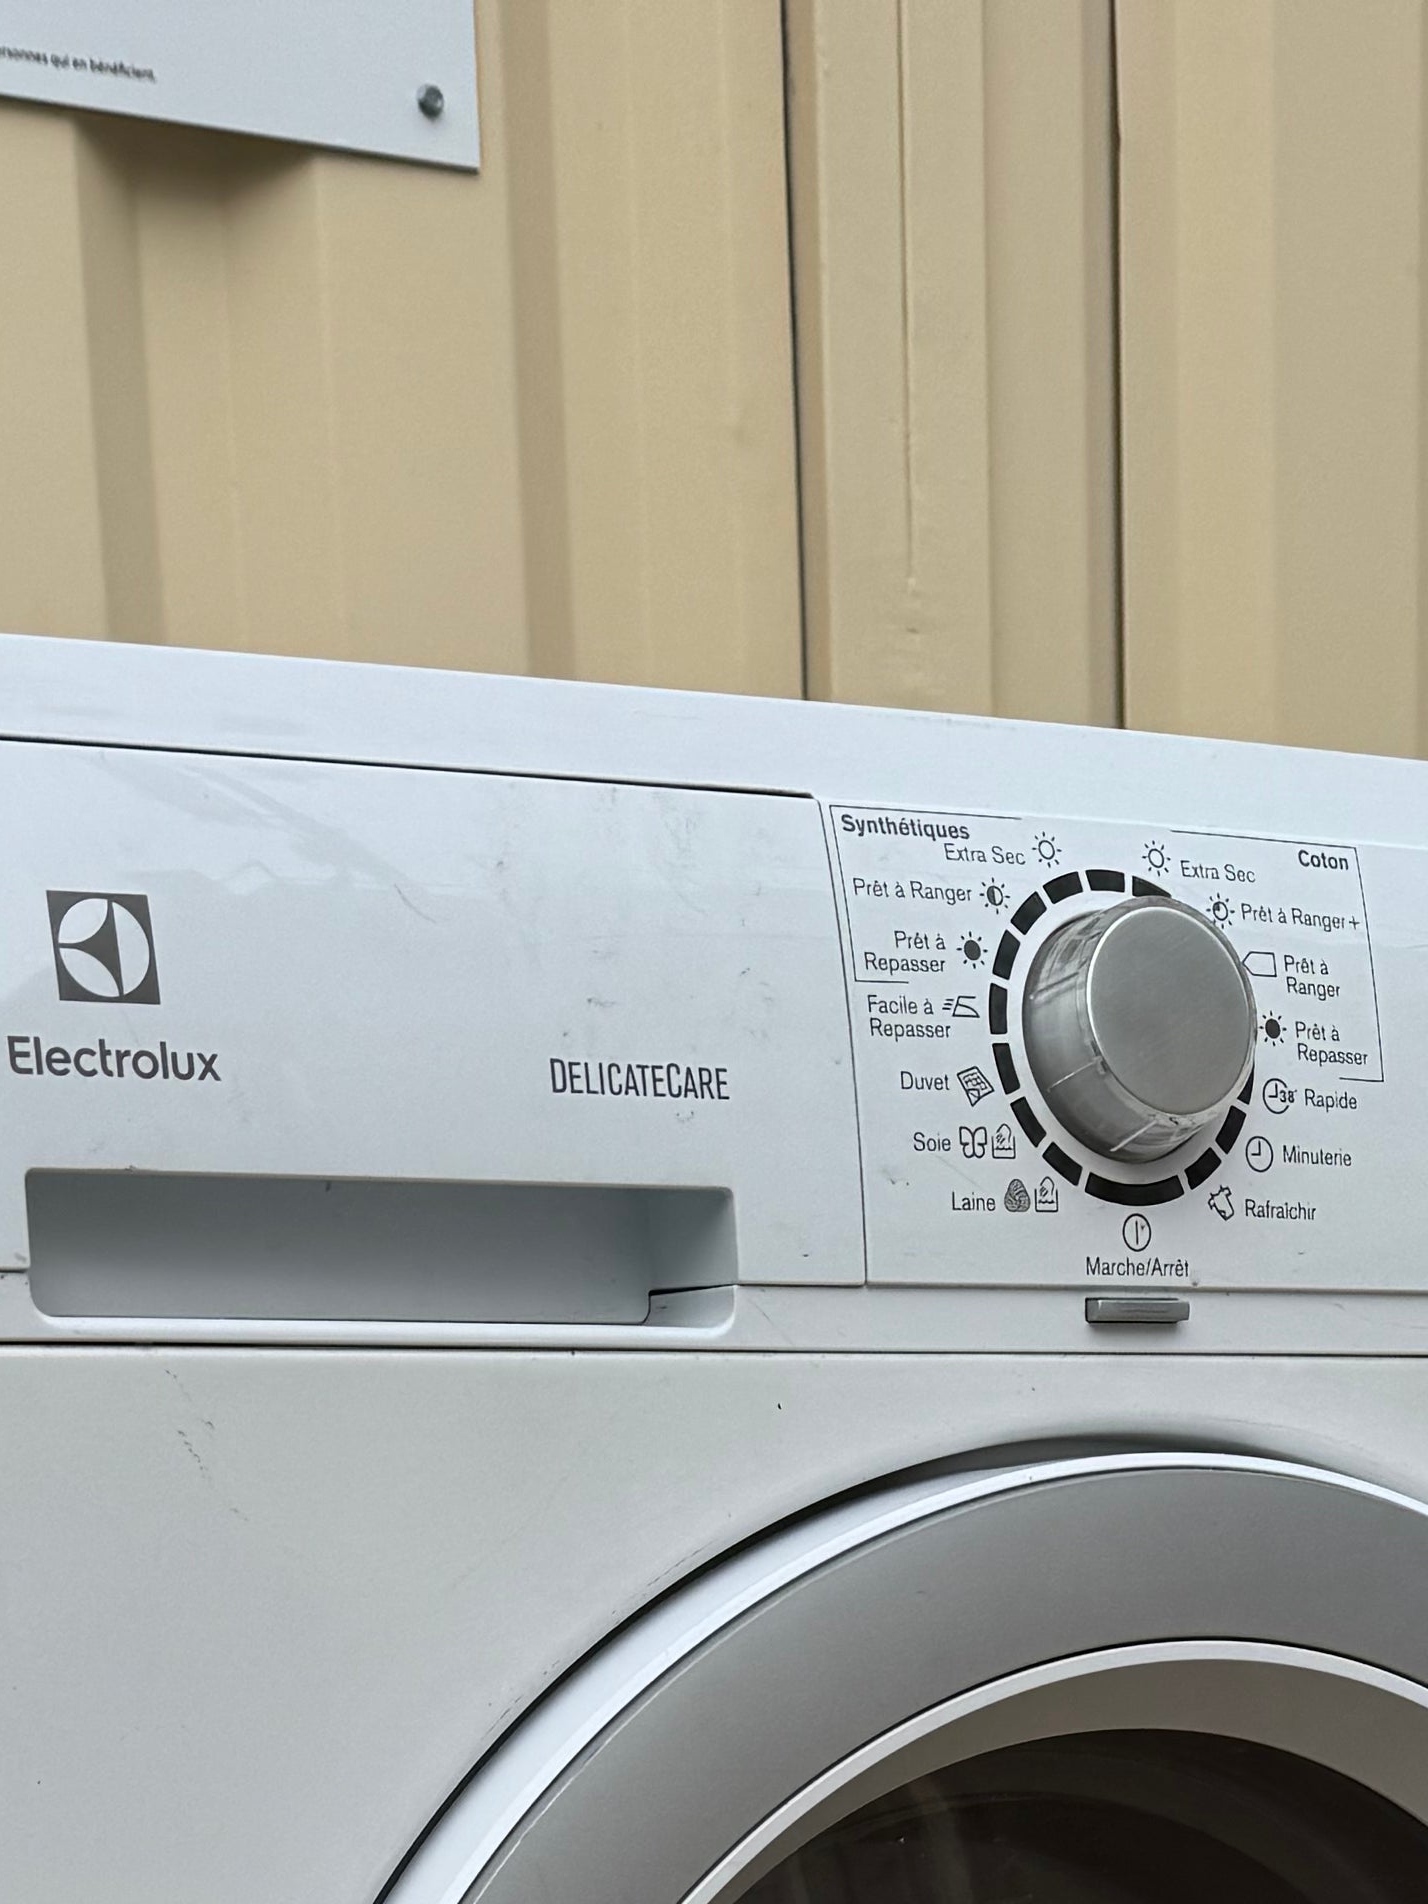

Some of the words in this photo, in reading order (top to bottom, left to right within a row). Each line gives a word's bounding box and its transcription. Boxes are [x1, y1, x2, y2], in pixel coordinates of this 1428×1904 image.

[50, 52, 70, 69] qui
[72, 56, 88, 71] en
[840, 813, 971, 842] Synthétiques
[943, 842, 988, 864] Extra
[991, 845, 1026, 866] Sec
[1297, 849, 1350, 871] Coton
[1180, 859, 1220, 881] Extra
[1224, 863, 1257, 884] Sec
[852, 877, 890, 899] Prêt
[894, 881, 906, 899] à
[909, 880, 973, 906] Ranger
[1240, 902, 1273, 925] Prêt
[1277, 907, 1288, 925] à
[1291, 907, 1346, 933] Ranger
[893, 929, 930, 951] Prêt
[934, 932, 947, 951] à
[863, 951, 946, 976] Repasser
[1283, 954, 1316, 975] Prêt
[1319, 959, 1330, 976] à
[1286, 976, 1341, 1002] Ranger
[867, 993, 918, 1016] Facile
[923, 997, 934, 1016] à
[869, 1017, 952, 1043] Repasser
[1294, 1020, 1327, 1042] Prêt
[1330, 1024, 1341, 1042] à
[6, 1034, 222, 1083] Electrolux
[1296, 1043, 1369, 1067] Repasser
[549, 1057, 731, 1101] DELICATECARE
[900, 1070, 951, 1091] Duvet
[1304, 1087, 1358, 1114] Rapide
[912, 1131, 952, 1152] Soie
[1282, 1144, 1353, 1168] Minuterie
[951, 1190, 997, 1212] Laine
[1244, 1197, 1317, 1222] Rafraîchir
[1084, 1256, 1190, 1278] Marche/Arrêt
